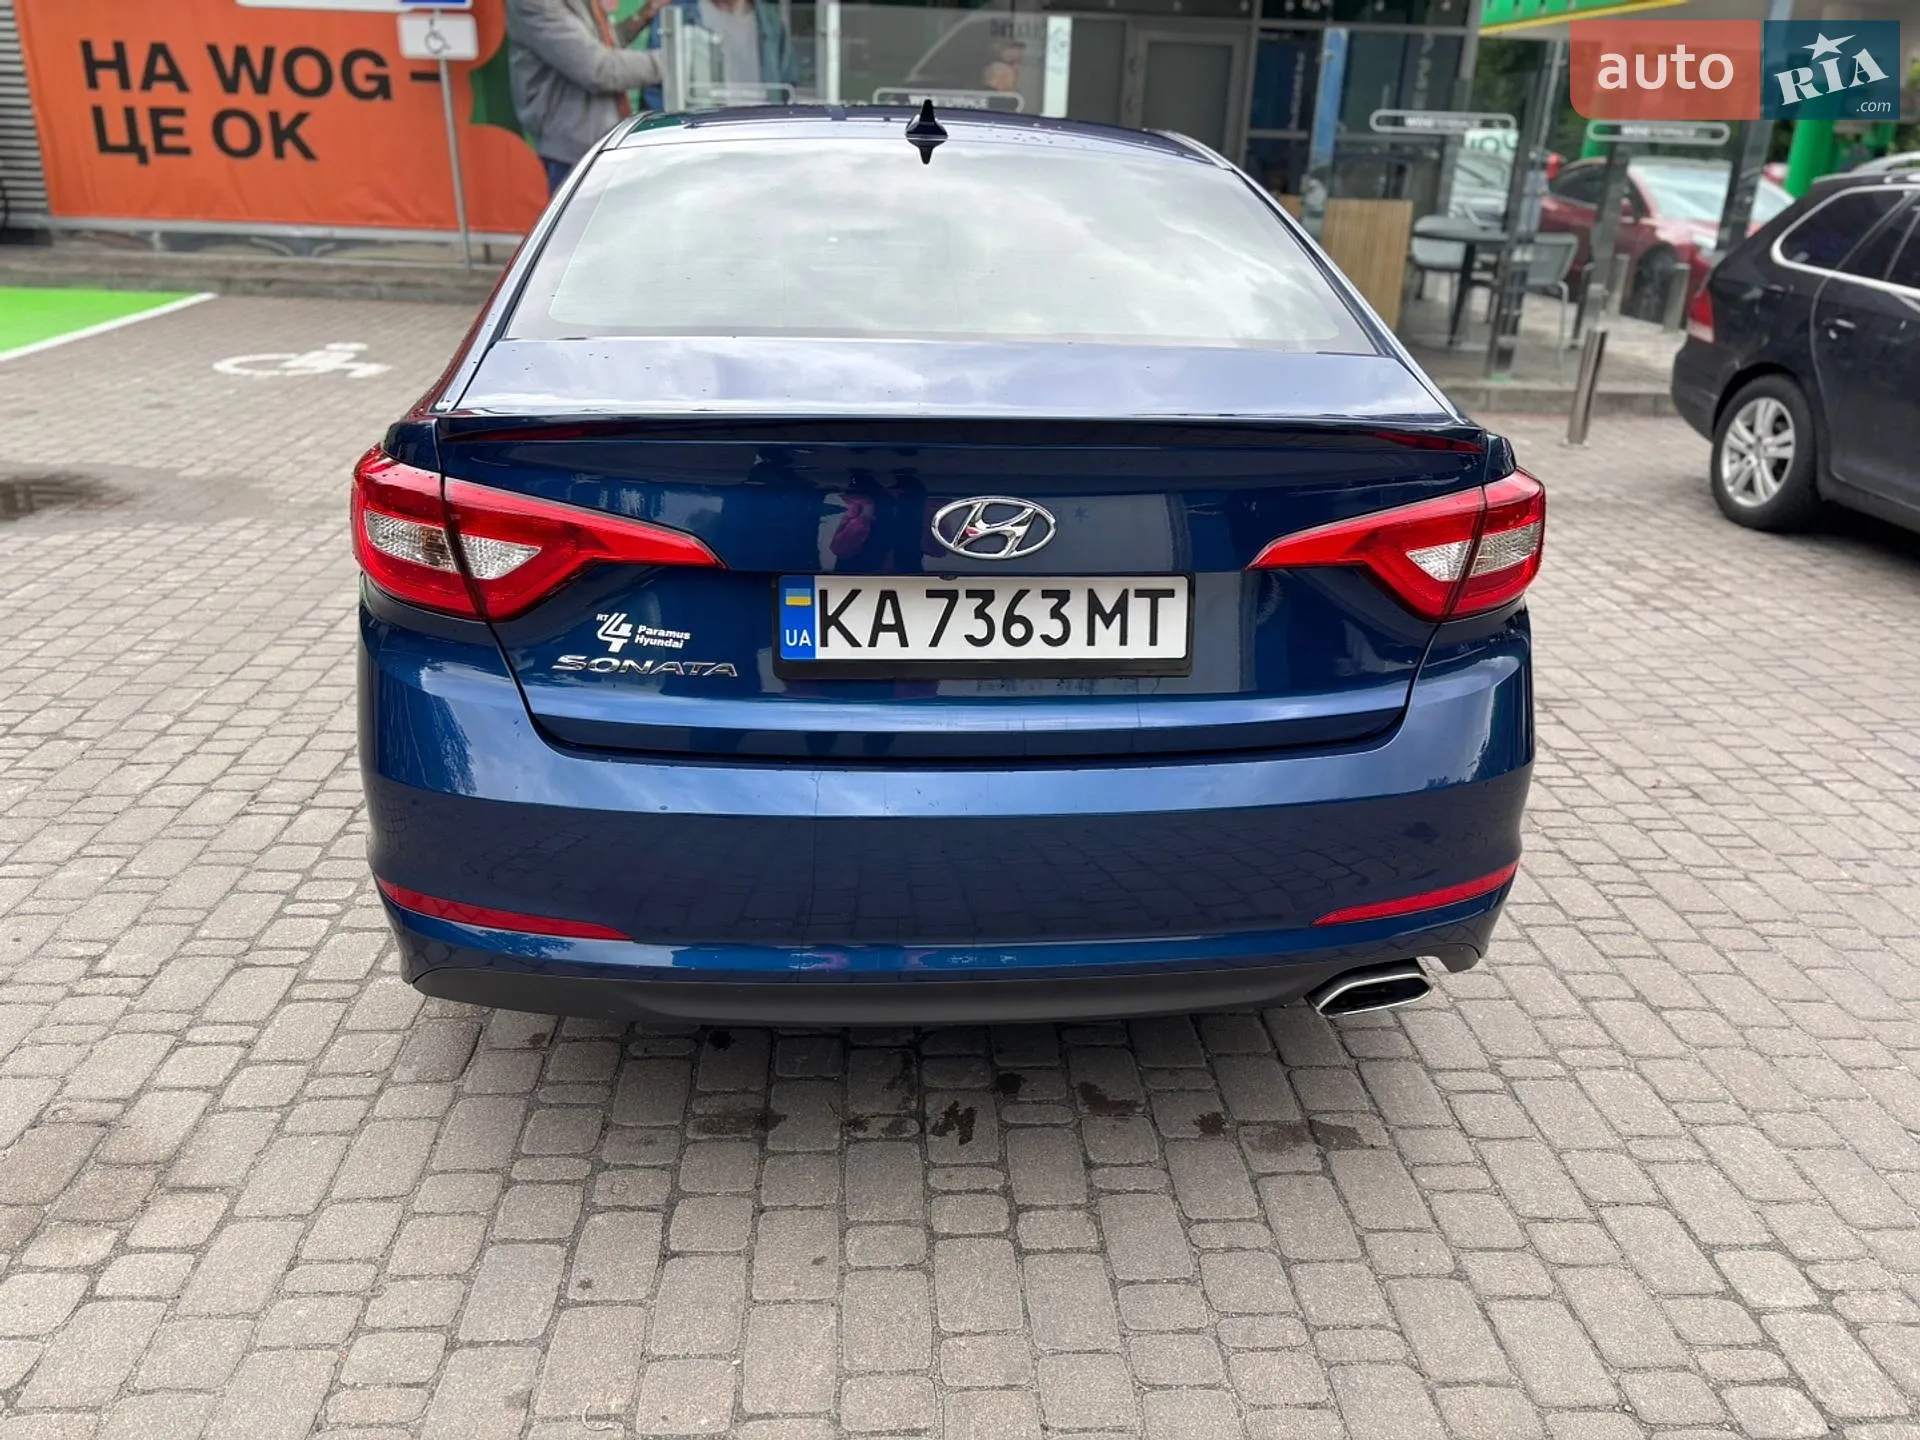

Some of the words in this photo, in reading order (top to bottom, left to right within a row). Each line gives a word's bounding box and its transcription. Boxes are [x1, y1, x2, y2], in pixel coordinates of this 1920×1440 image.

[79, 39, 191, 93] НА
[206, 43, 394, 101] WOG
[91, 105, 193, 166] ЦЕ
[818, 588, 910, 648] KA
[924, 588, 1072, 648] 7363
[1085, 587, 1176, 647] MT
[634, 634, 684, 649] Hyundai
[637, 624, 691, 640] Paramus
[785, 629, 812, 647] UA
[551, 654, 739, 677] SONATA
